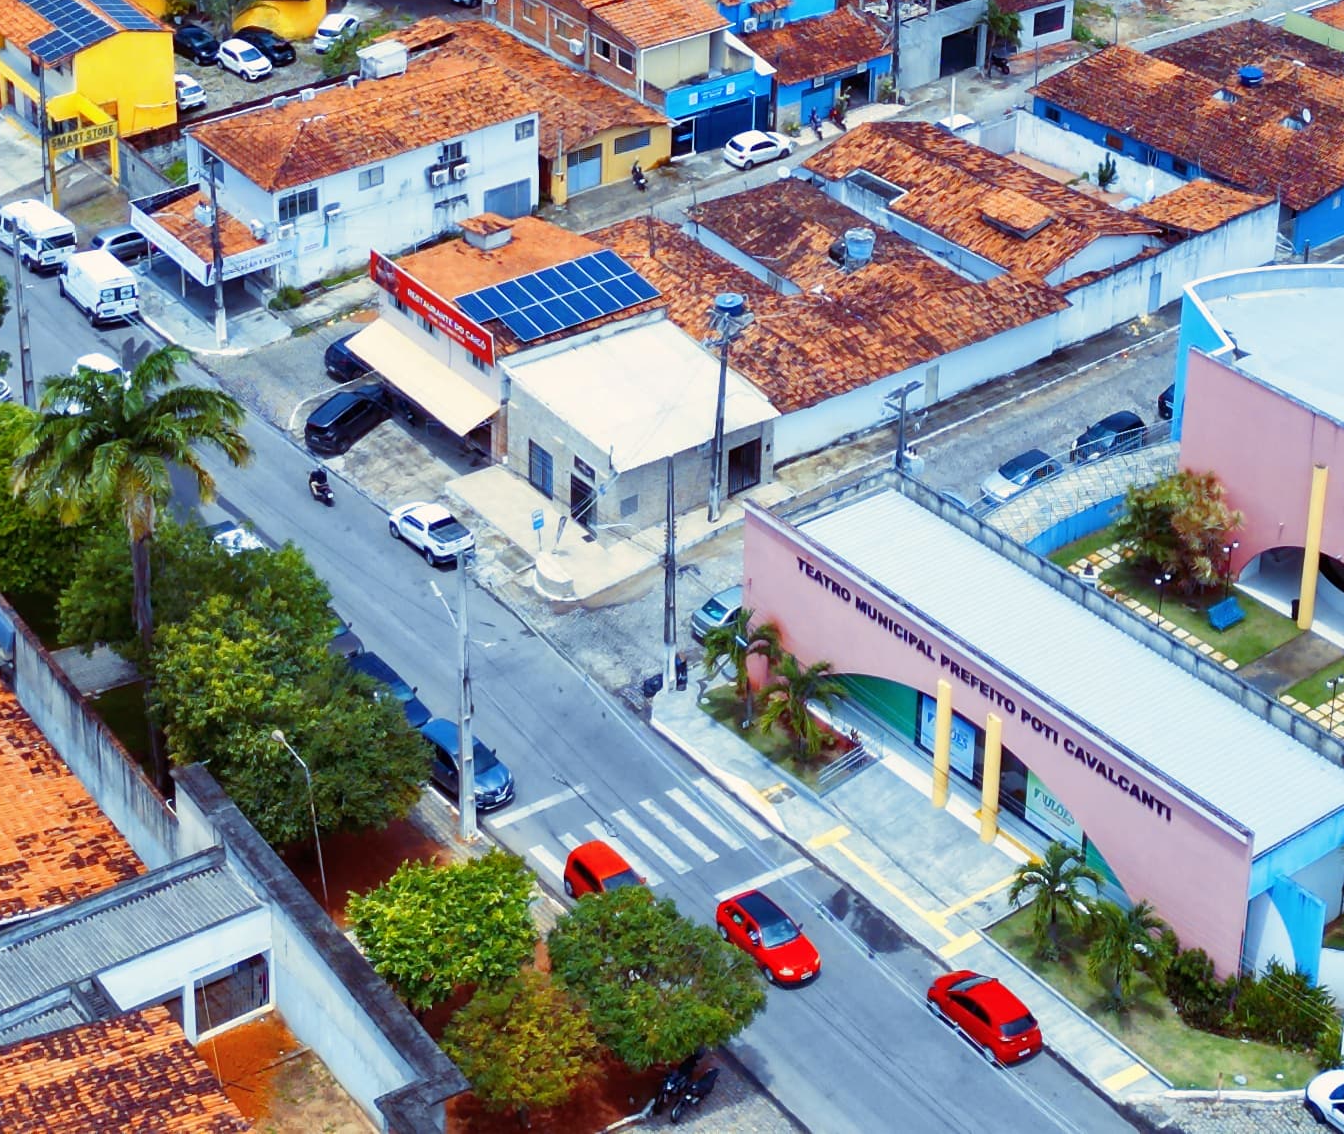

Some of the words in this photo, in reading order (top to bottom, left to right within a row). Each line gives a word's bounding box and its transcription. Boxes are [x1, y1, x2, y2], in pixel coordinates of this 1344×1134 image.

[51, 132, 84, 147] SMART
[86, 125, 114, 139] STORE
[407, 288, 453, 327] RESTAURANTE
[454, 322, 465, 335] DO
[796, 556, 851, 603] TEATRO
[855, 596, 936, 661] MUNICIPAL
[940, 653, 1016, 714] PREFEITO
[1021, 708, 1060, 746] POTI
[1063, 737, 1172, 822] CAVALCANTI
